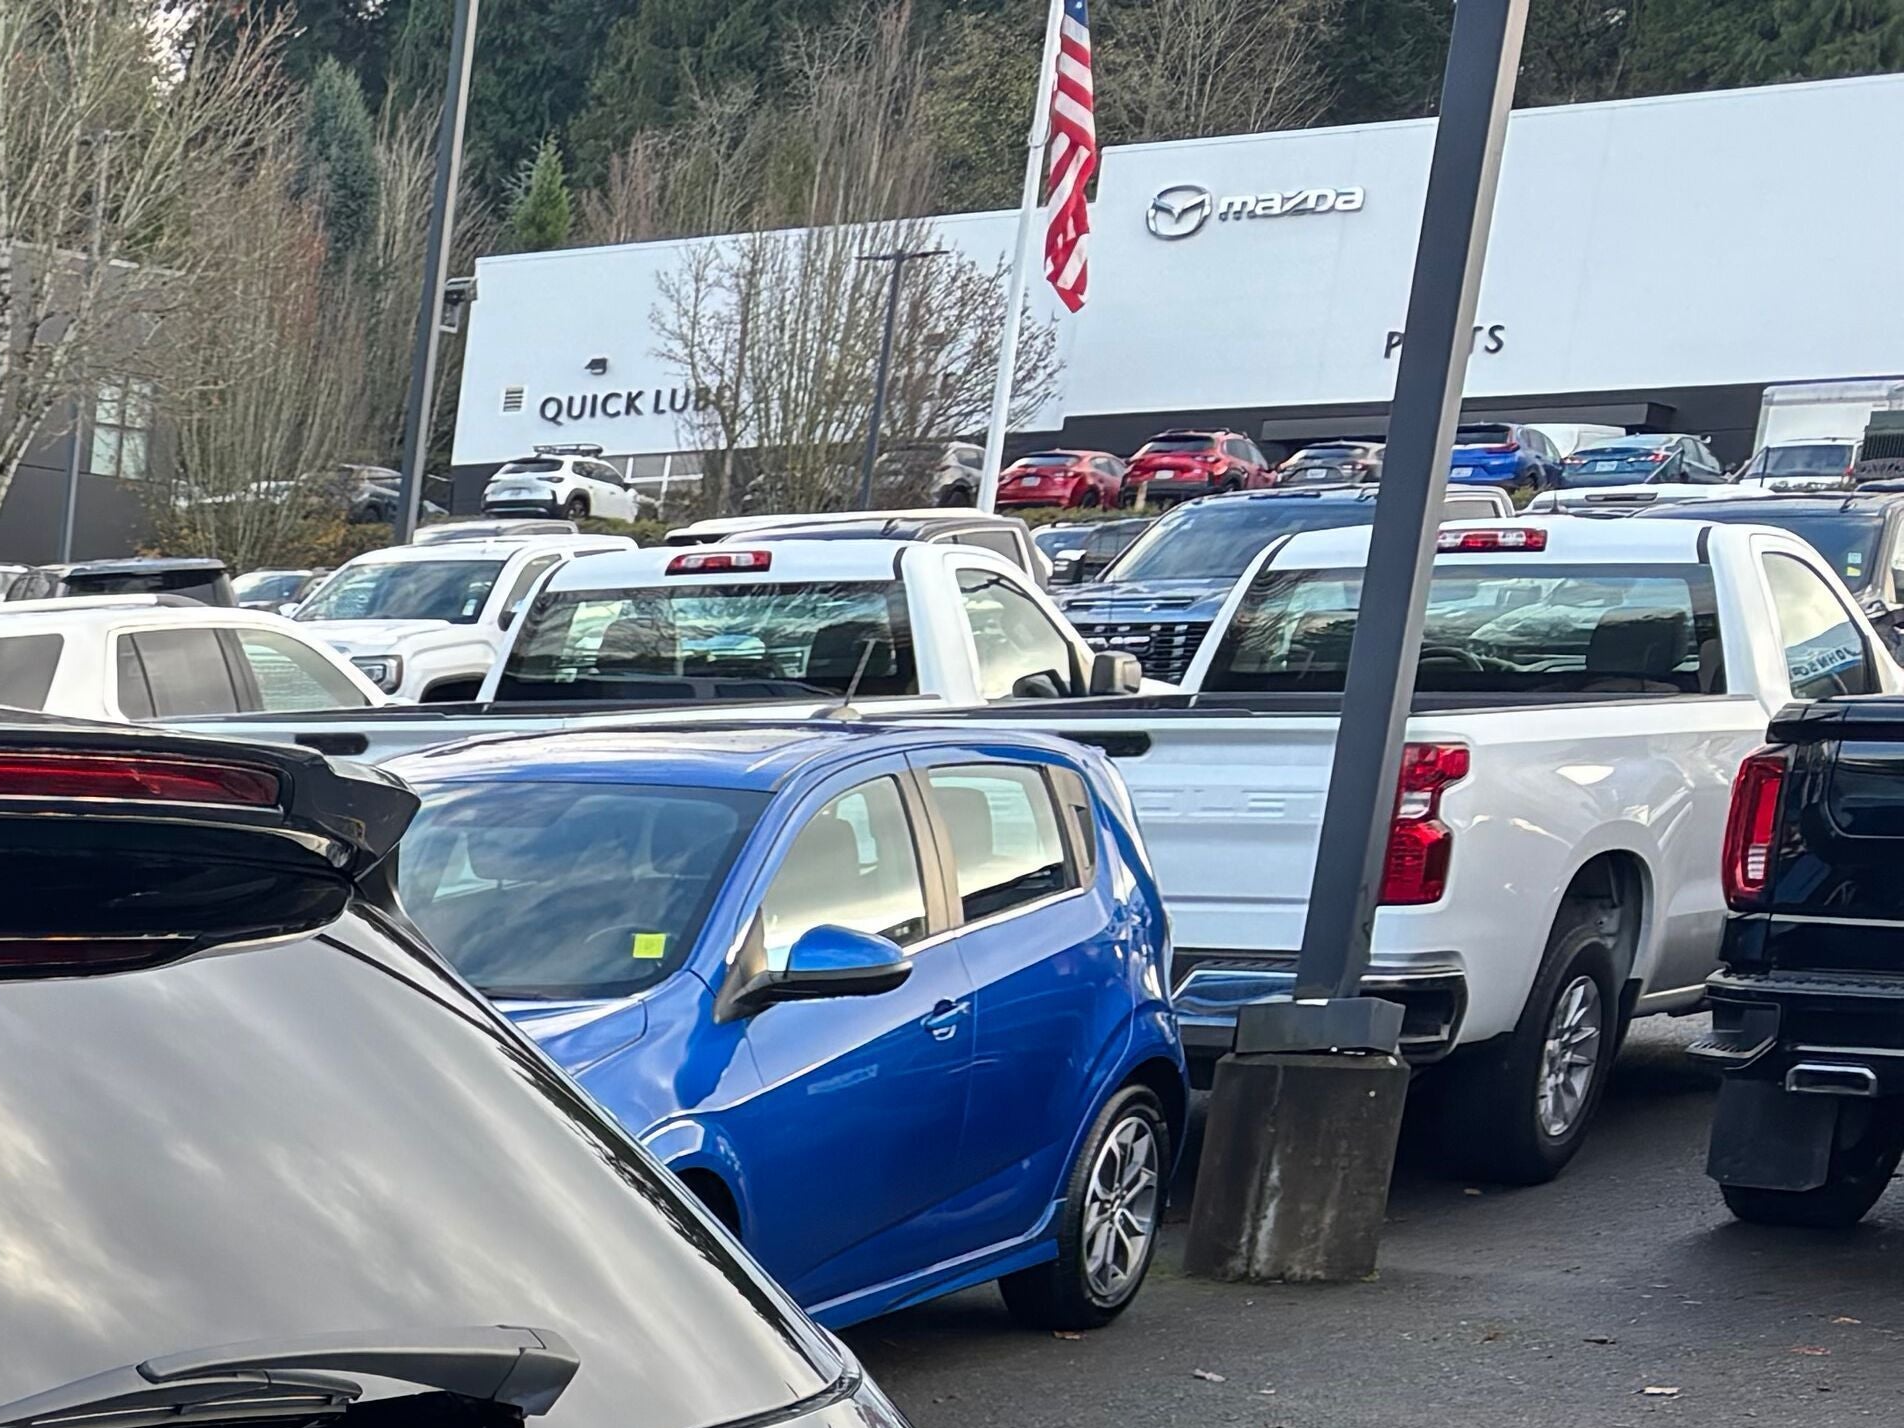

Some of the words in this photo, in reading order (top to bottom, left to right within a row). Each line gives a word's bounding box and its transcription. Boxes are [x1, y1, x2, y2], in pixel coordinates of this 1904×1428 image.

[1218, 186, 1366, 222] mazda
[539, 390, 645, 426] QUICK
[653, 384, 728, 414] LUB
